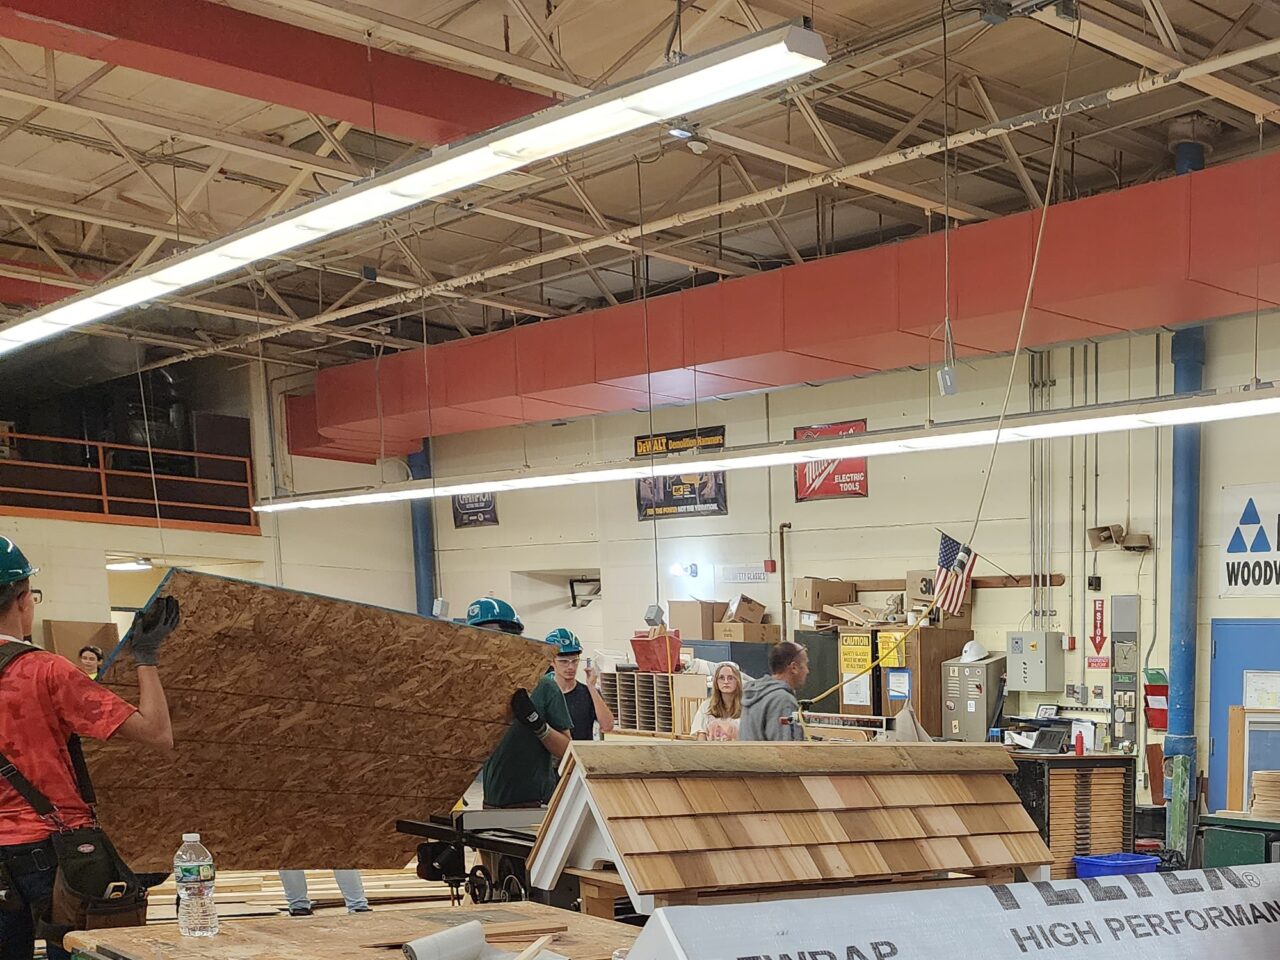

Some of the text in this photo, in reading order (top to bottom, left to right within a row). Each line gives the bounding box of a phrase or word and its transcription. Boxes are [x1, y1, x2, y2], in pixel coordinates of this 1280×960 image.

[834, 472, 865, 483] ELECTRIC
[839, 482, 860, 491] TOOLS
[843, 636, 869, 646] CAUTION
[1010, 919, 1102, 953] HIGH
